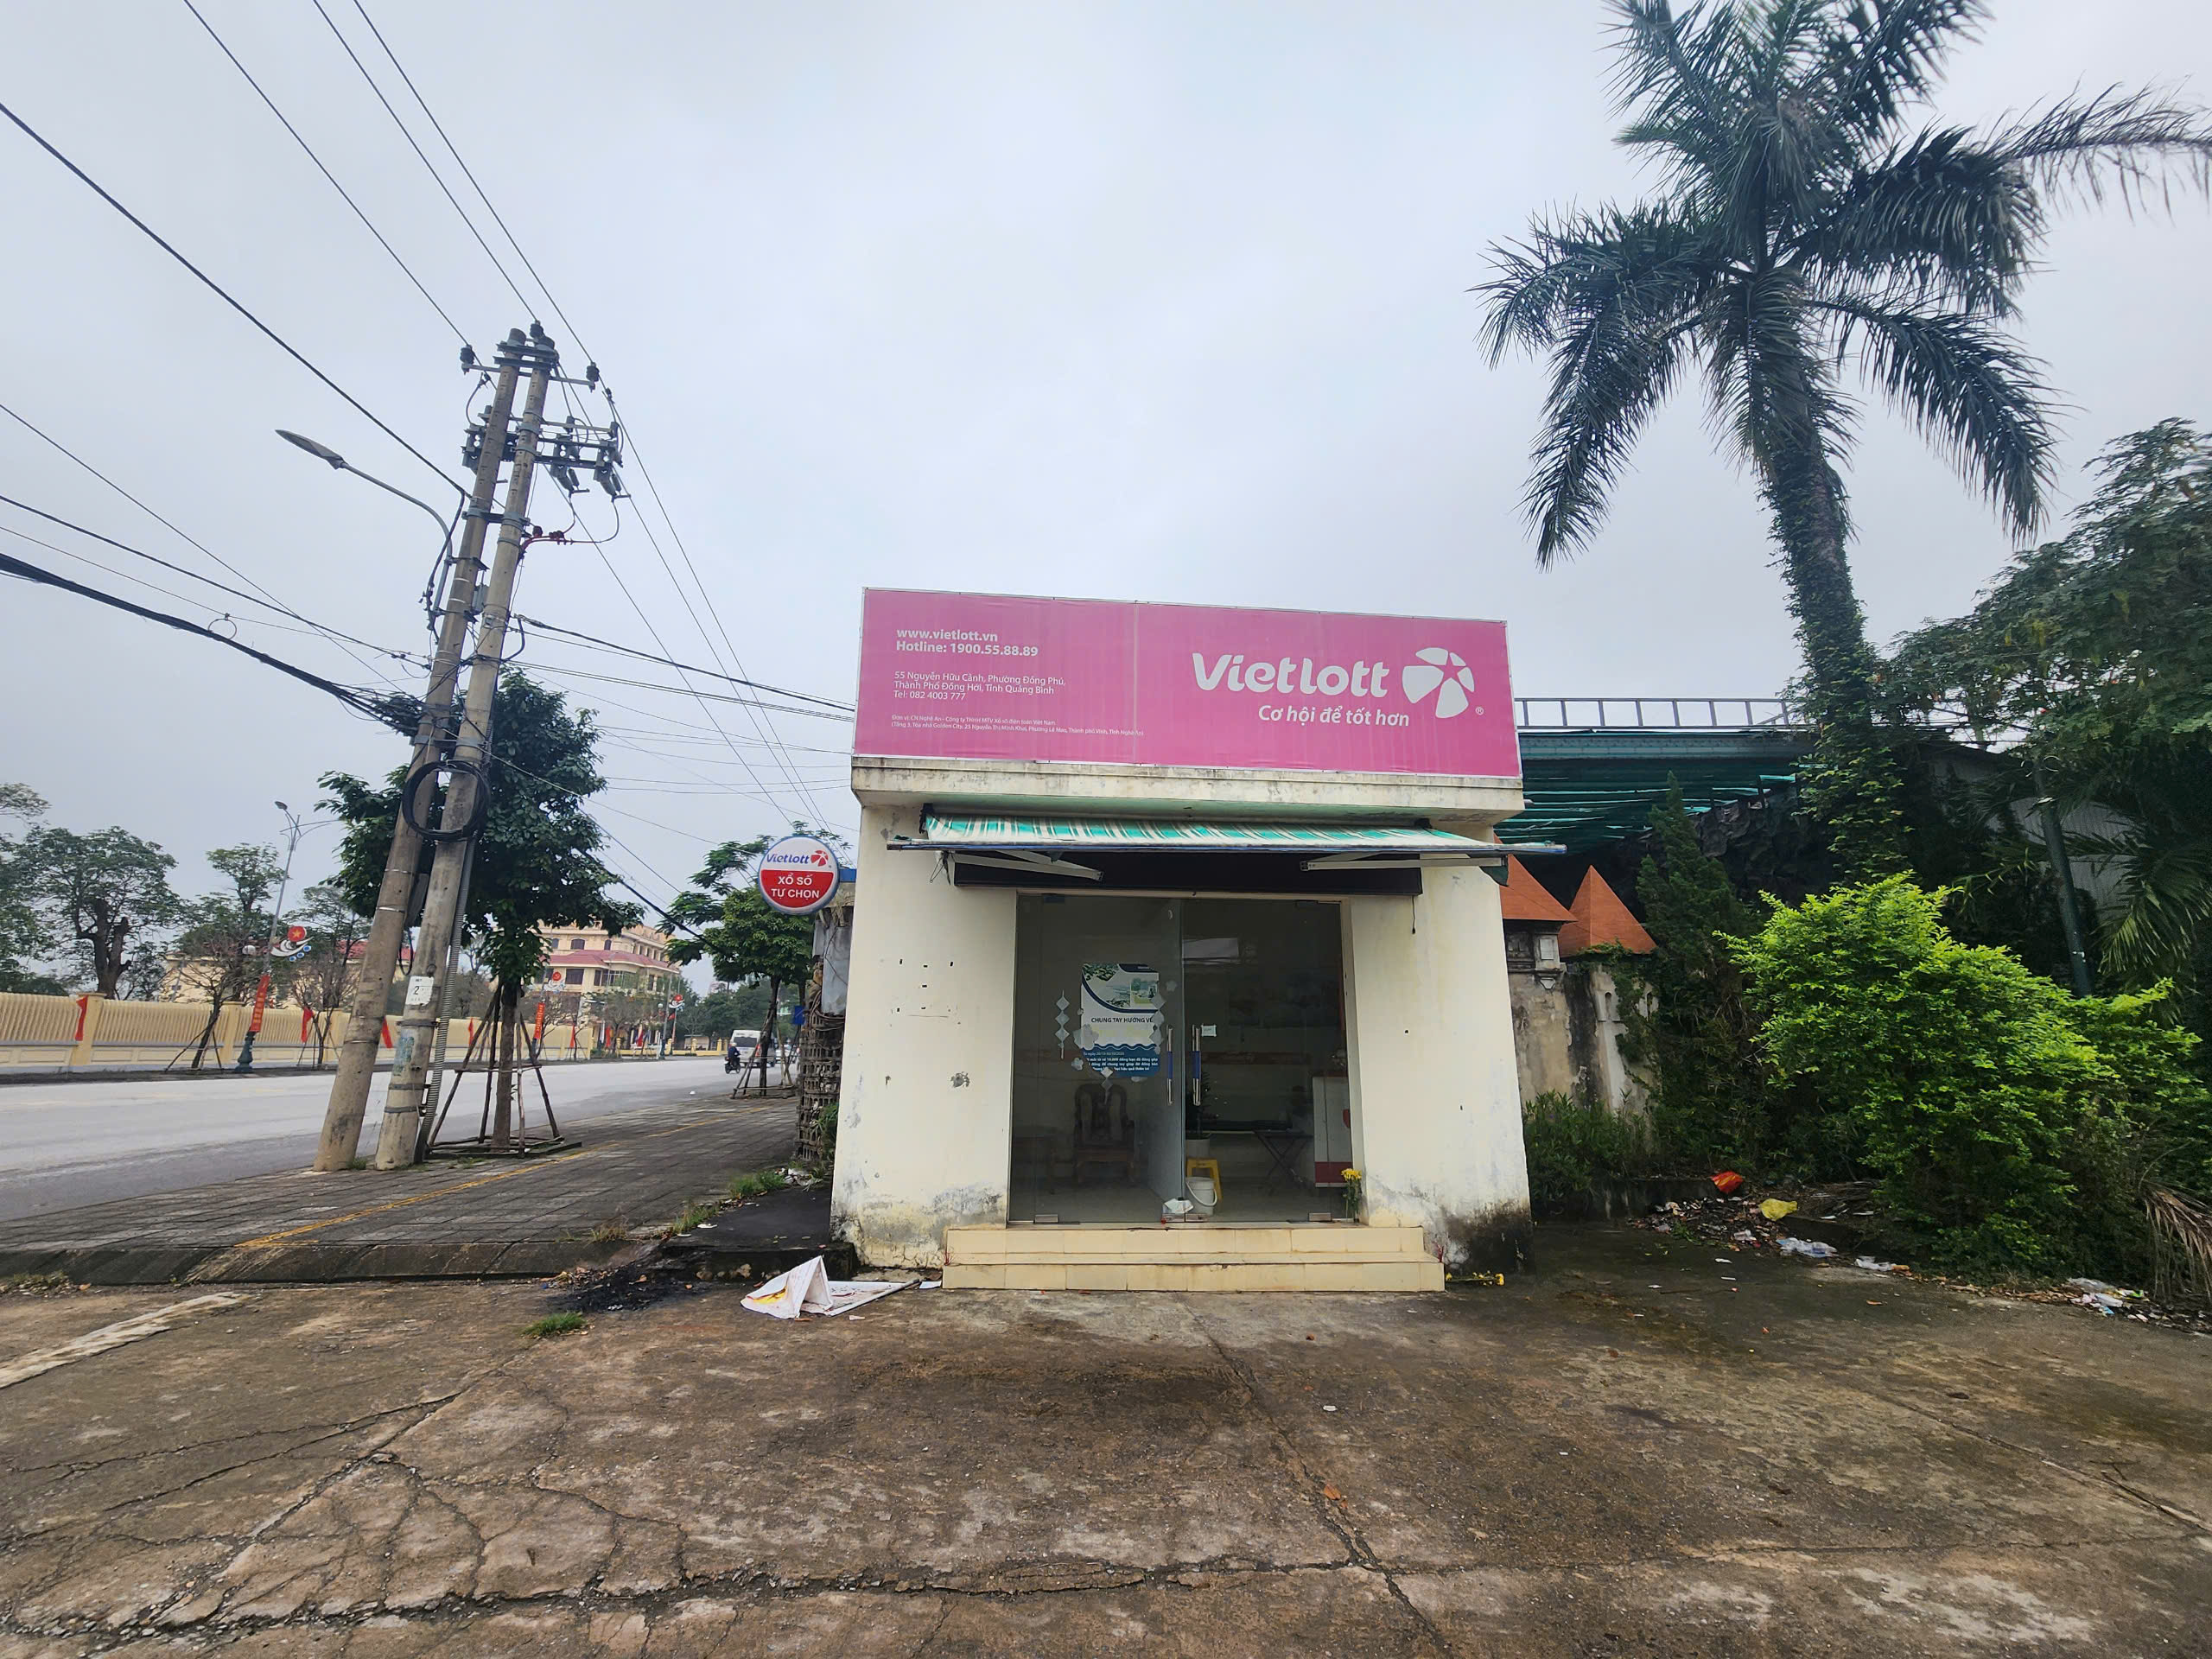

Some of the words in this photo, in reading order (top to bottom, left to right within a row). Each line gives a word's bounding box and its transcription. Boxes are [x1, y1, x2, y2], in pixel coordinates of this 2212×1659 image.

[896, 629, 998, 642] www.vietlott.vn
[896, 641, 947, 652] Hotline:
[950, 643, 1039, 657] 1900.55.88.89
[907, 671, 940, 682] Nguyễn
[962, 673, 986, 683] Cảnh,
[988, 674, 1020, 685] Phường
[1192, 652, 1390, 698] Vietlott
[893, 681, 920, 690] Thành
[923, 681, 939, 690] Phố
[942, 682, 964, 692] Đồng
[967, 683, 983, 692] Hới,
[985, 683, 1003, 692] Tỉnh
[1005, 684, 1033, 696] Quảng
[1035, 685, 1054, 694] Bình
[1259, 705, 1282, 721] Cơ
[1287, 707, 1315, 726] hội
[1319, 705, 1342, 724] để
[1346, 707, 1370, 725] tốt
[1376, 709, 1409, 727] hơn
[766, 854, 810, 864] Vietlott
[778, 872, 793, 885] XỔ
[796, 874, 812, 886] SỐ
[771, 888, 785, 899] TỰ
[787, 889, 820, 900] CHỌN
